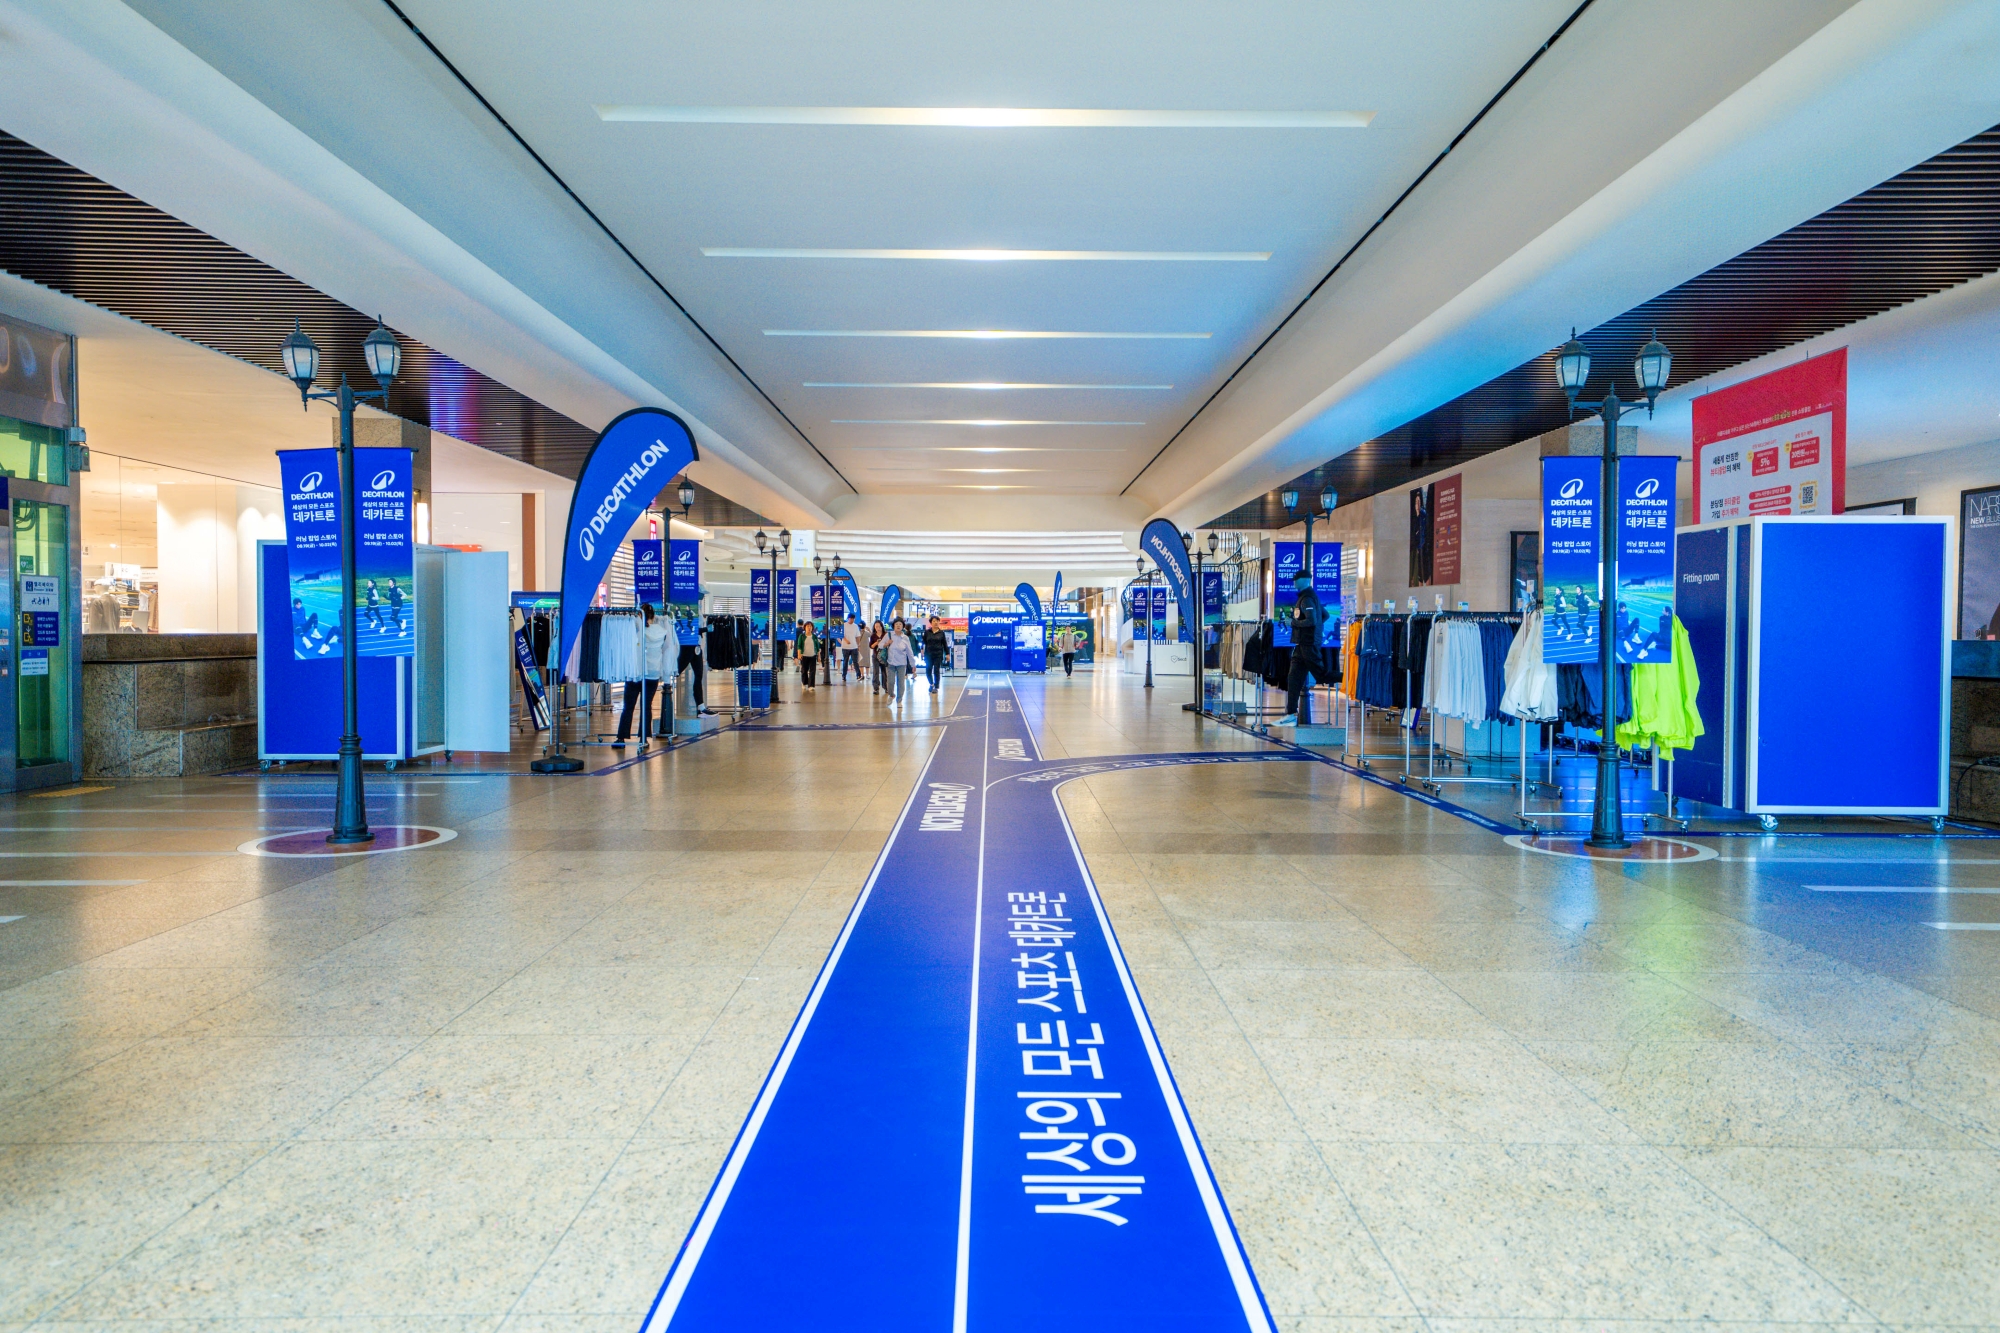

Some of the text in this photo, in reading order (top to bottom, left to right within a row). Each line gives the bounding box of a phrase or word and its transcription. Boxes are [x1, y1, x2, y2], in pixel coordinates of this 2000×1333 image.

[590, 439, 670, 535] DECATHLON
[290, 492, 334, 500] DECATHLON
[293, 509, 335, 522] 데카트론
[363, 508, 404, 521] 데카트론
[1551, 516, 1592, 528] 데카트론
[1626, 516, 1667, 528] 데카트론
[1683, 573, 1720, 584] Fitting room
[918, 790, 968, 831] DECATHLON
[1008, 892, 1145, 1226] 세상의 모든 스포츠 데카트론
